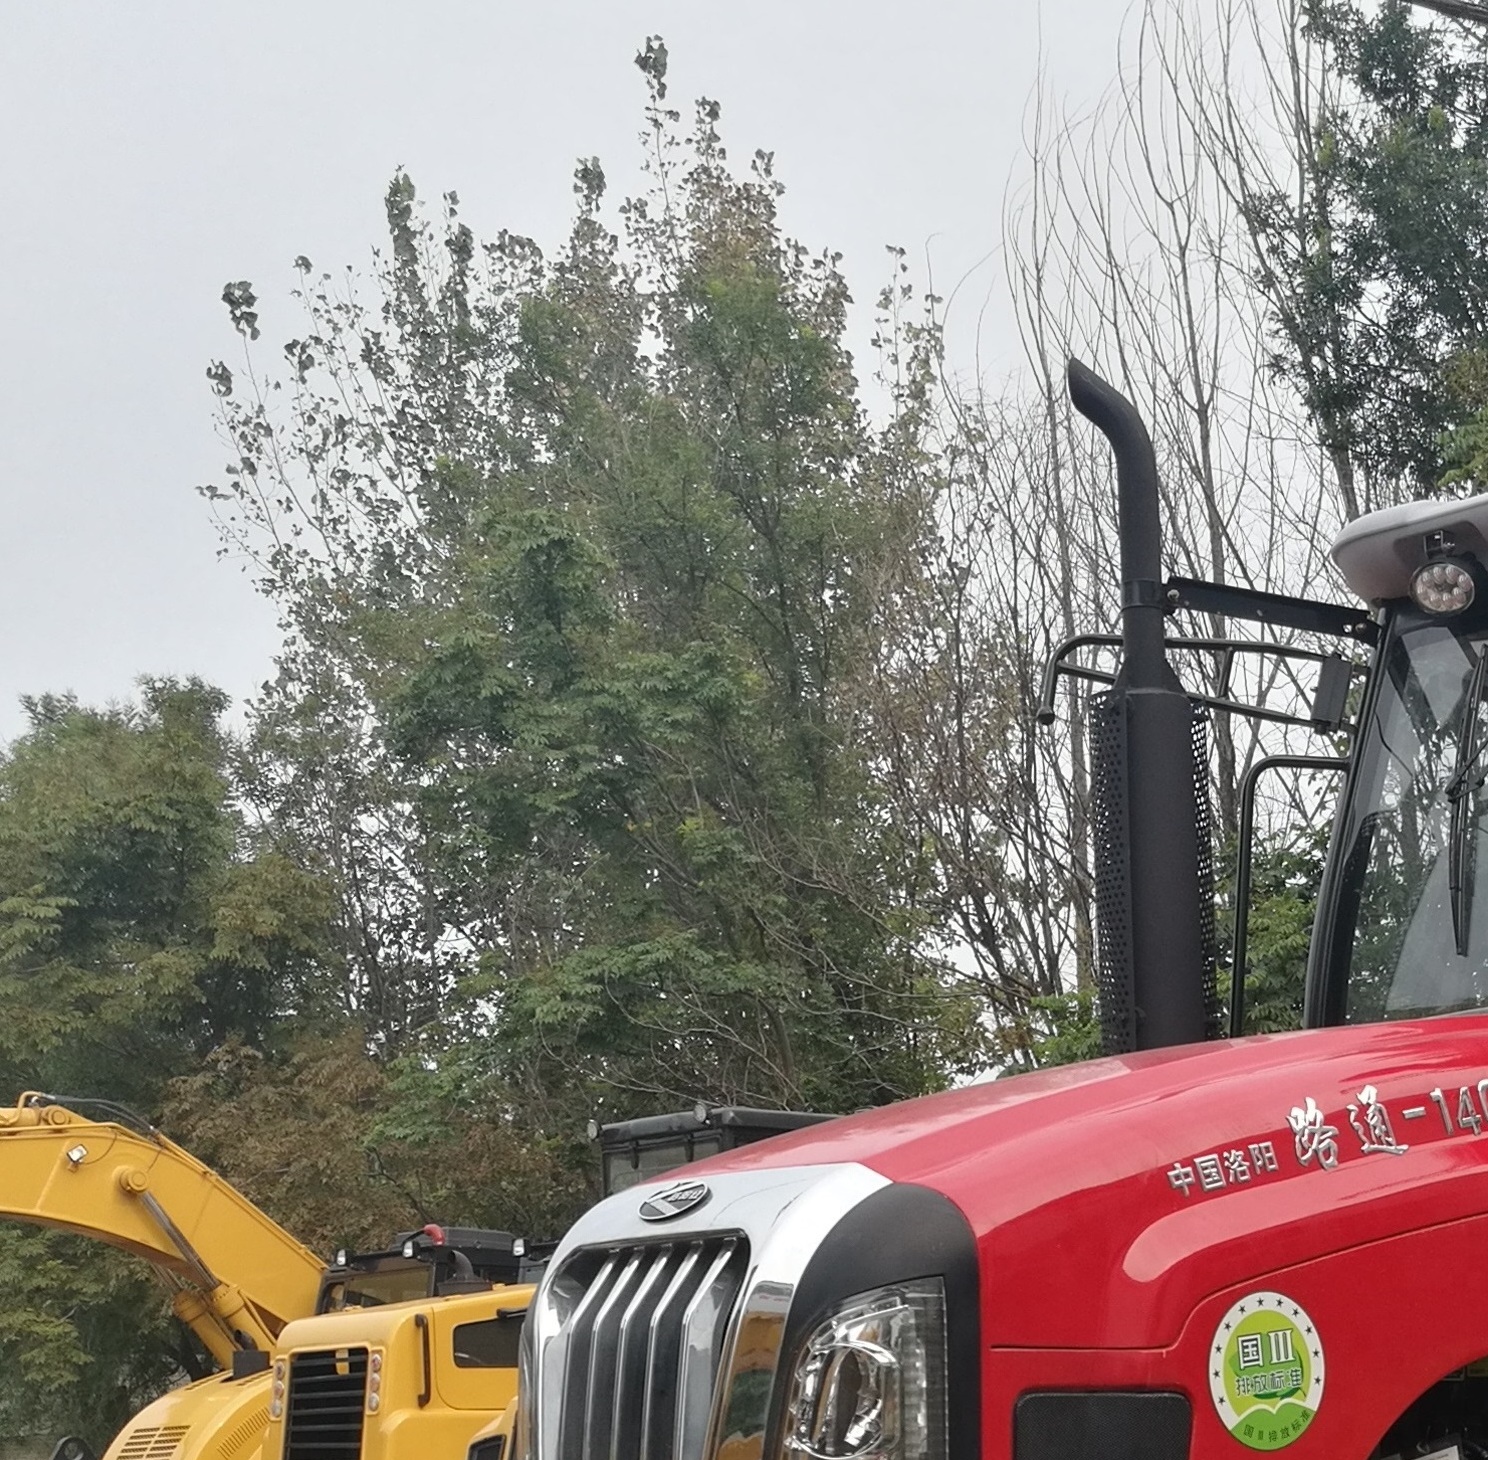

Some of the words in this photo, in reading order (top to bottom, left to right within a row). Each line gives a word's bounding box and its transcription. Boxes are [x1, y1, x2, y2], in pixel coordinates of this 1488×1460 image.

[1166, 1141, 1280, 1198] 中国洛阳
[1235, 1367, 1303, 1397] 排放标准
